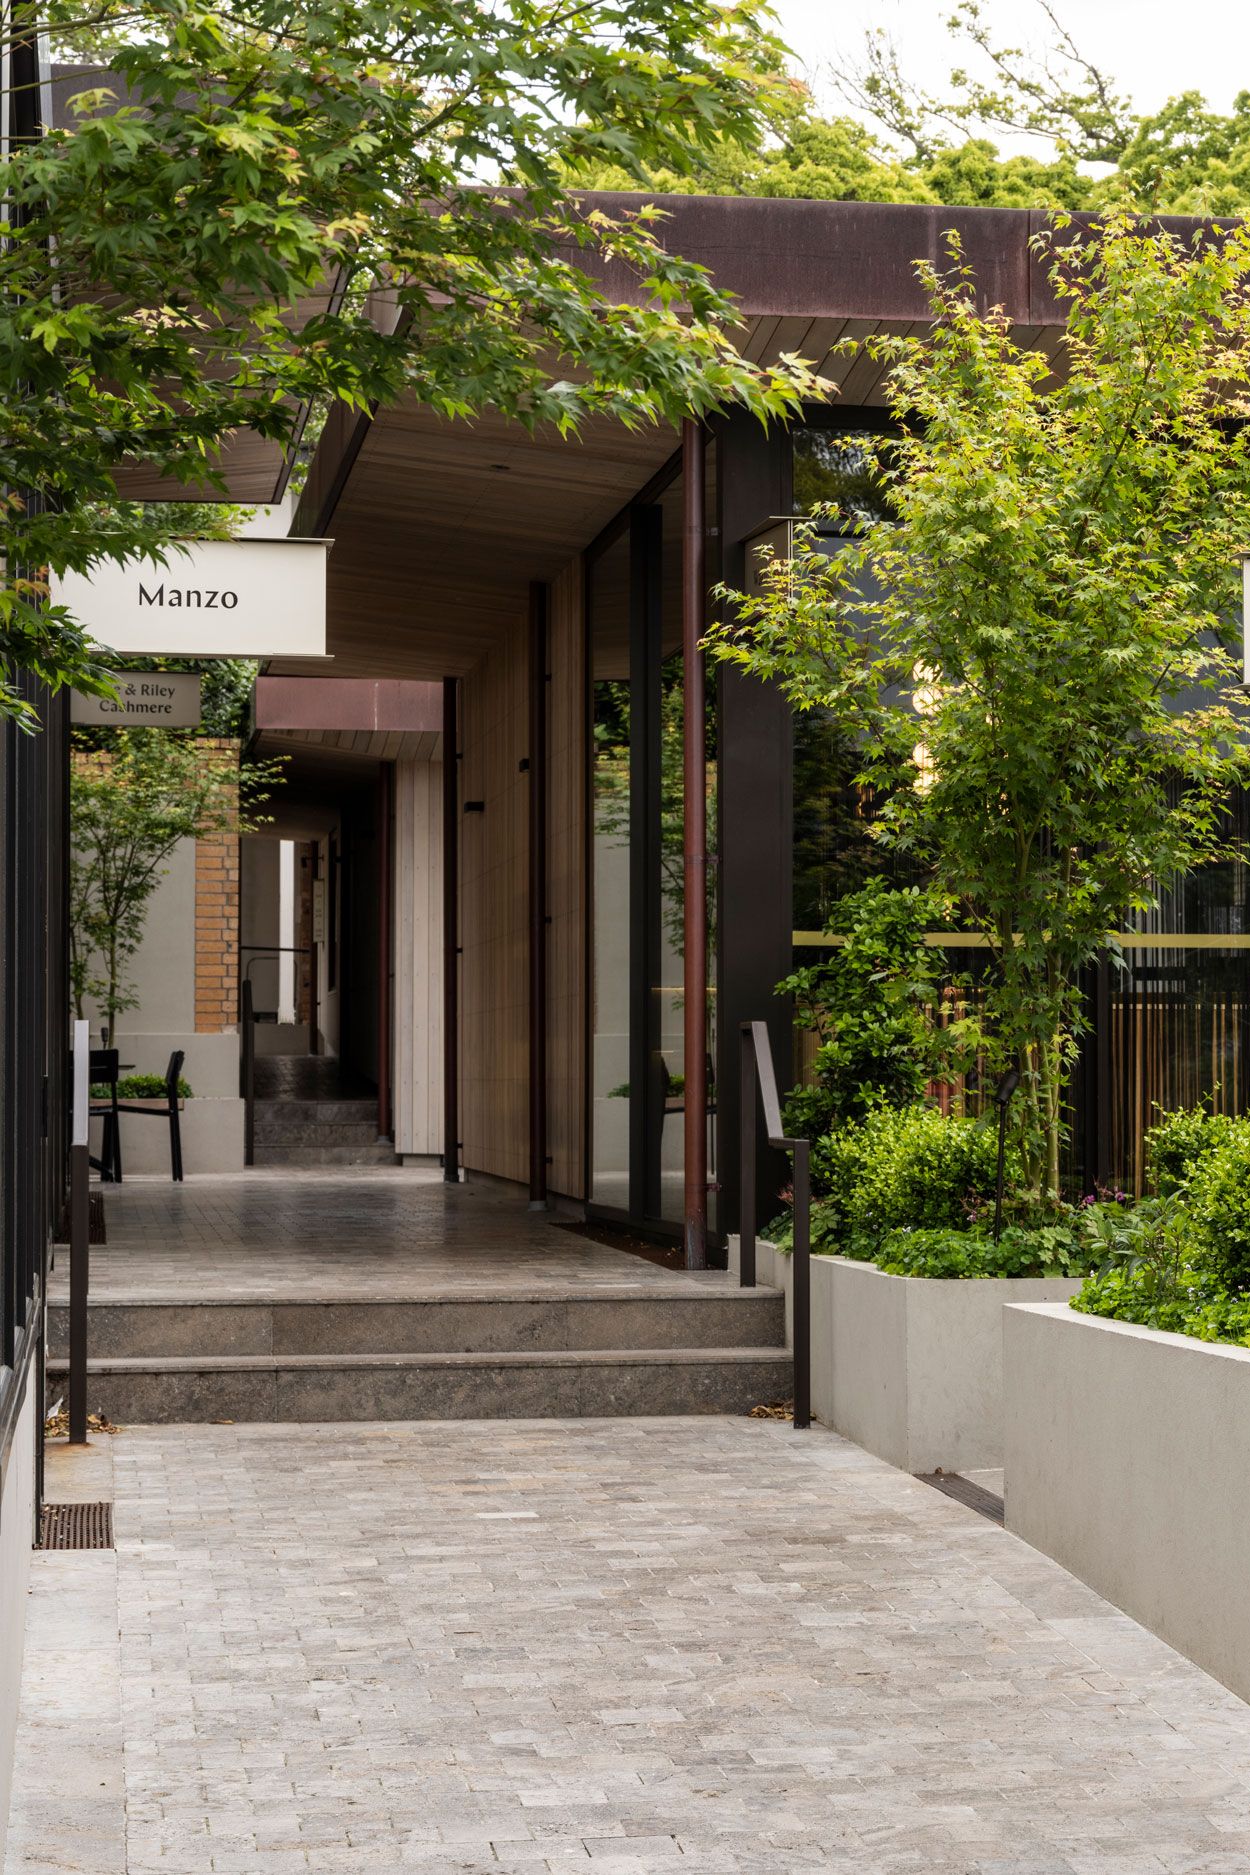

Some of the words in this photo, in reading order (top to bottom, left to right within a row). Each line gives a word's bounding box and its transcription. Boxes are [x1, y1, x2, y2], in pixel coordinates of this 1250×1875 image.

[138, 582, 239, 609] Manzo
[124, 683, 137, 696] &
[140, 684, 176, 699] Riley
